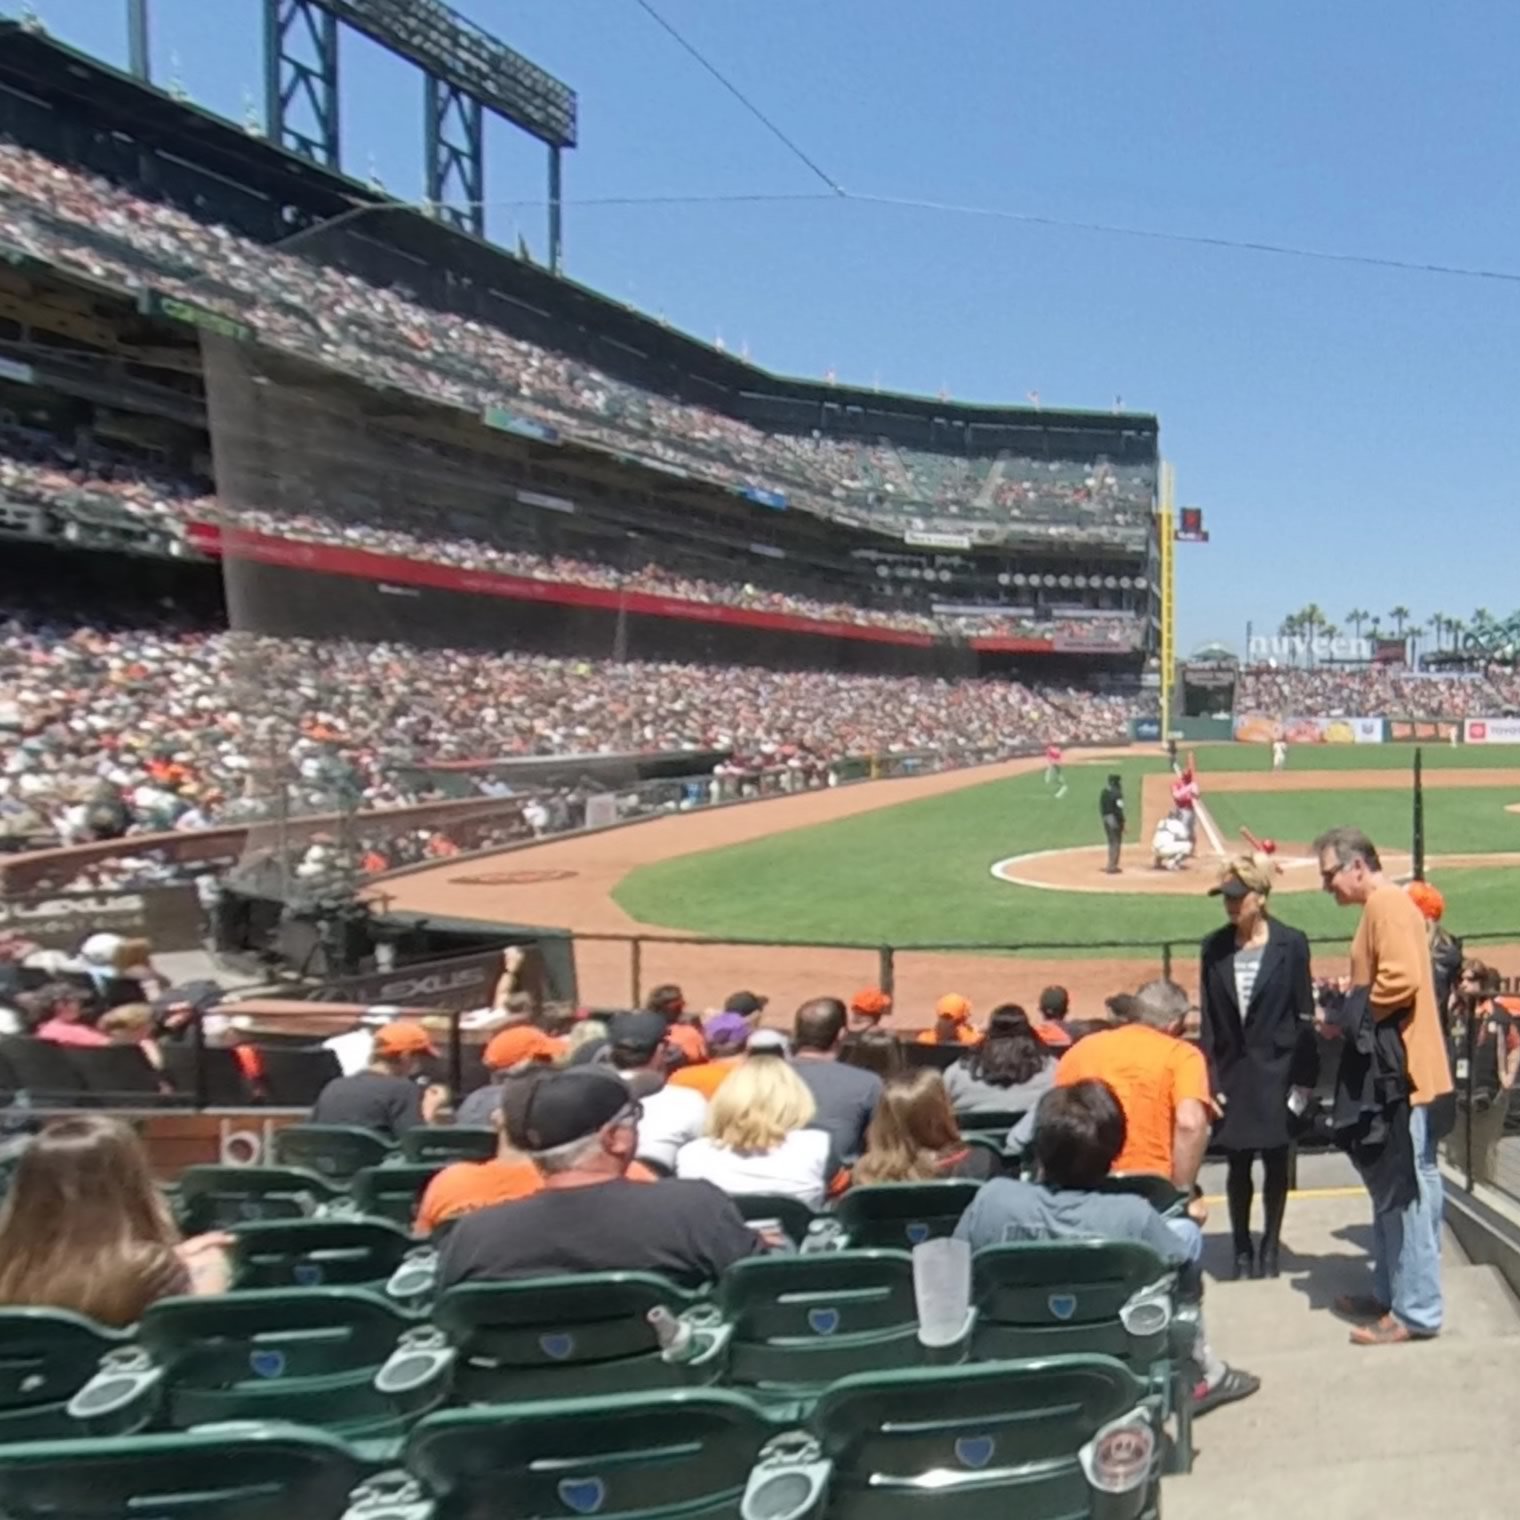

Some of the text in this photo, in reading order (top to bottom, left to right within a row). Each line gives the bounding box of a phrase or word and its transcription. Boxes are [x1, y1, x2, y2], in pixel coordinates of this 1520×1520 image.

[1250, 634, 1371, 661] nuveen
[13, 894, 144, 918] LEXUS
[356, 967, 485, 1003] LEXUS
